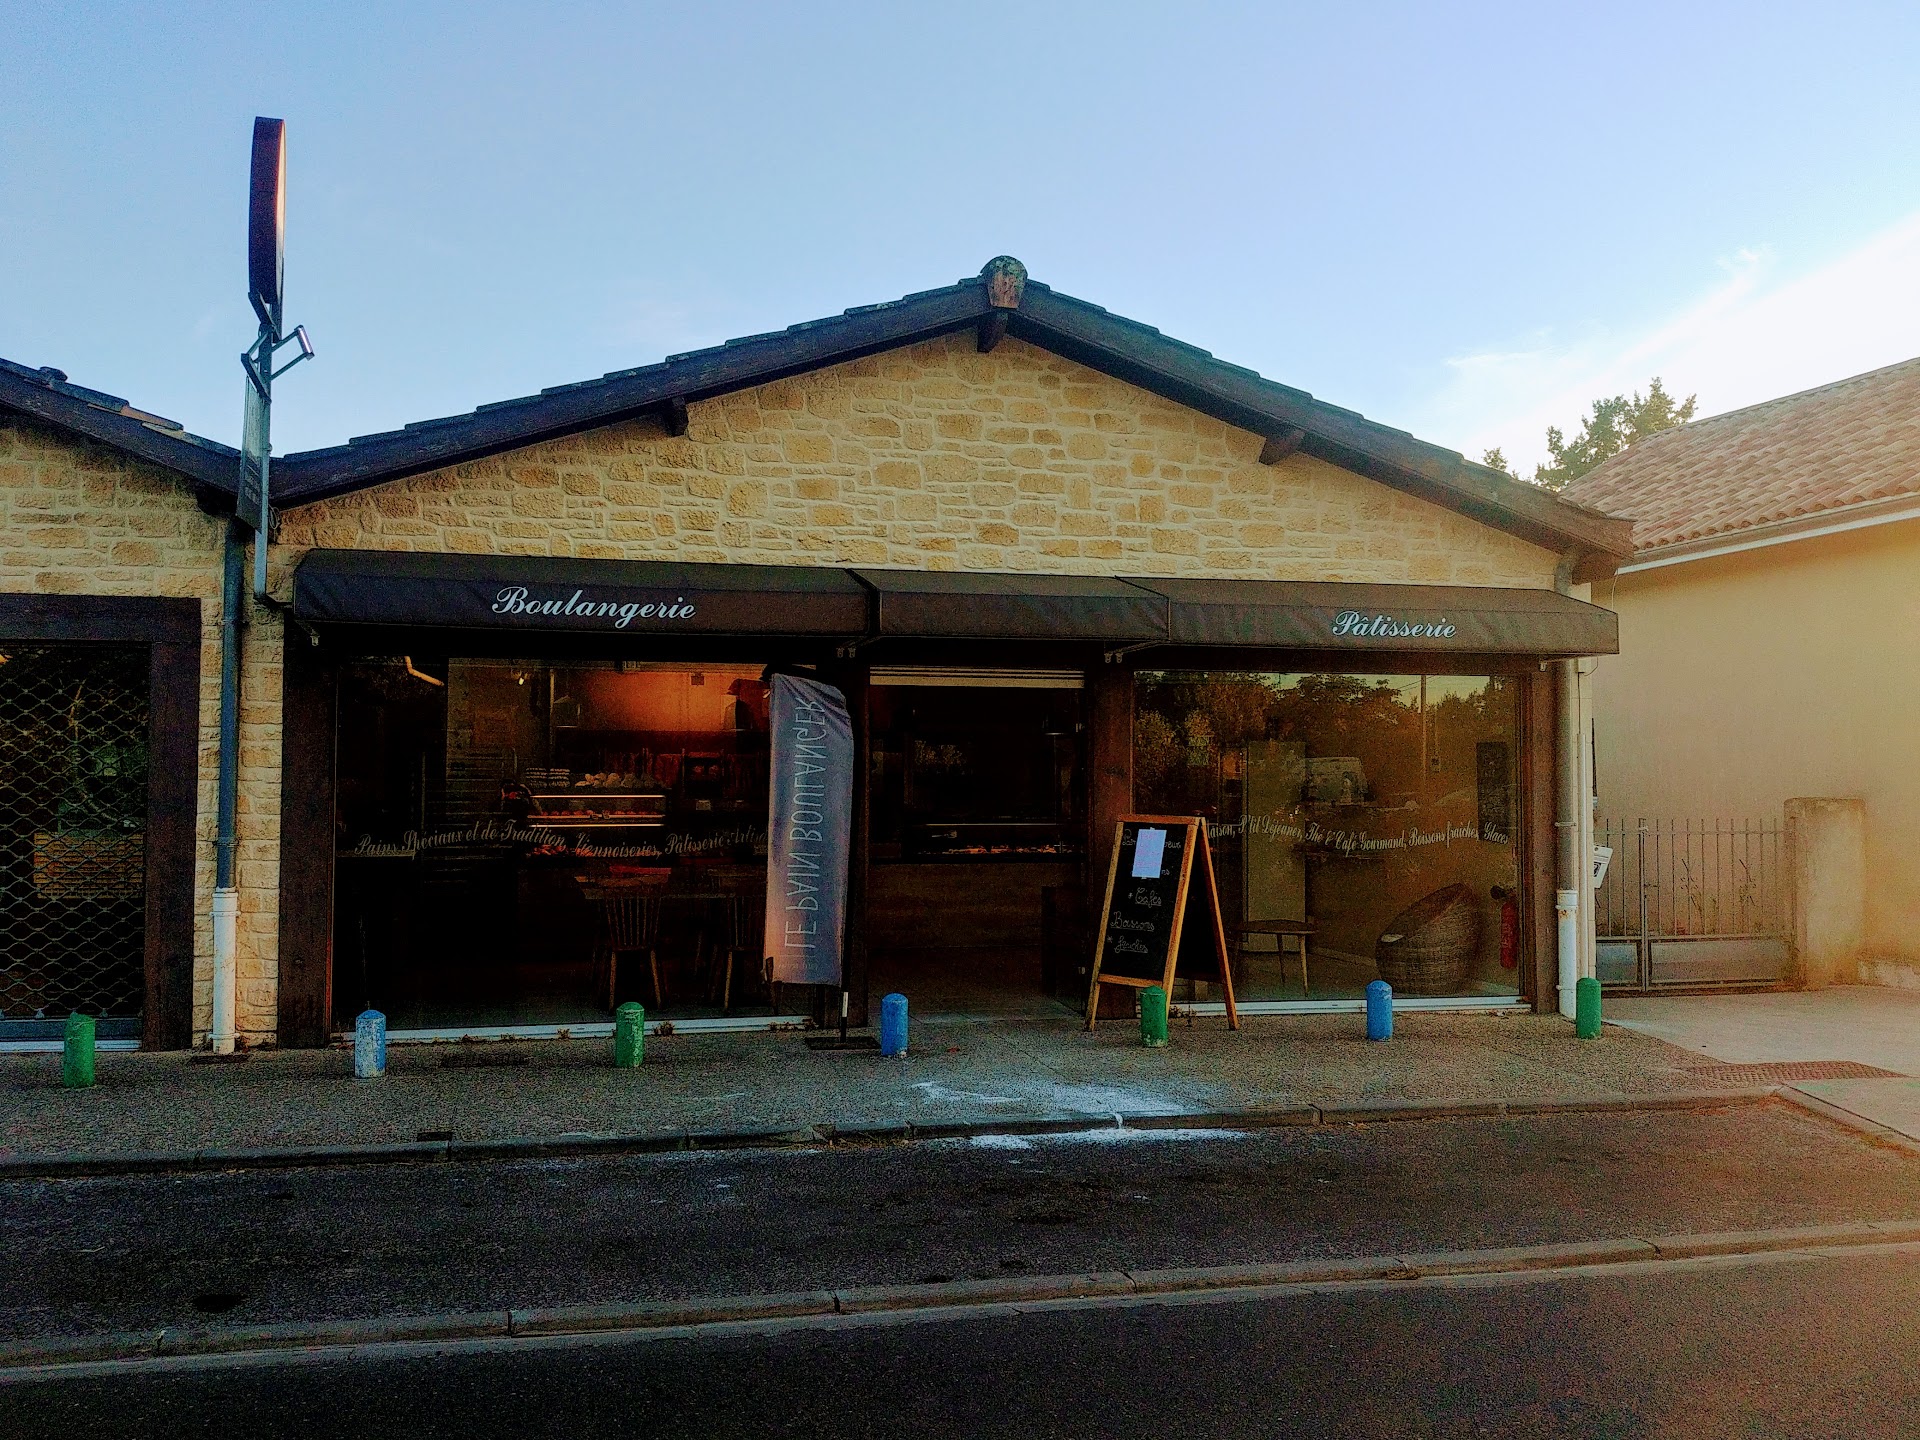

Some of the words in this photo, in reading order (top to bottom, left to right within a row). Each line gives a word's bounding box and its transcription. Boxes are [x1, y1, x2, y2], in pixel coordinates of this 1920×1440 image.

[492, 586, 696, 629] Boulangerie
[1332, 610, 1457, 638] Pâtisserie
[465, 819, 480, 842] et
[480, 819, 497, 841] de
[1335, 830, 1359, 858] Café
[1408, 828, 1445, 848] Boissons
[1484, 821, 1510, 845] Glaces
